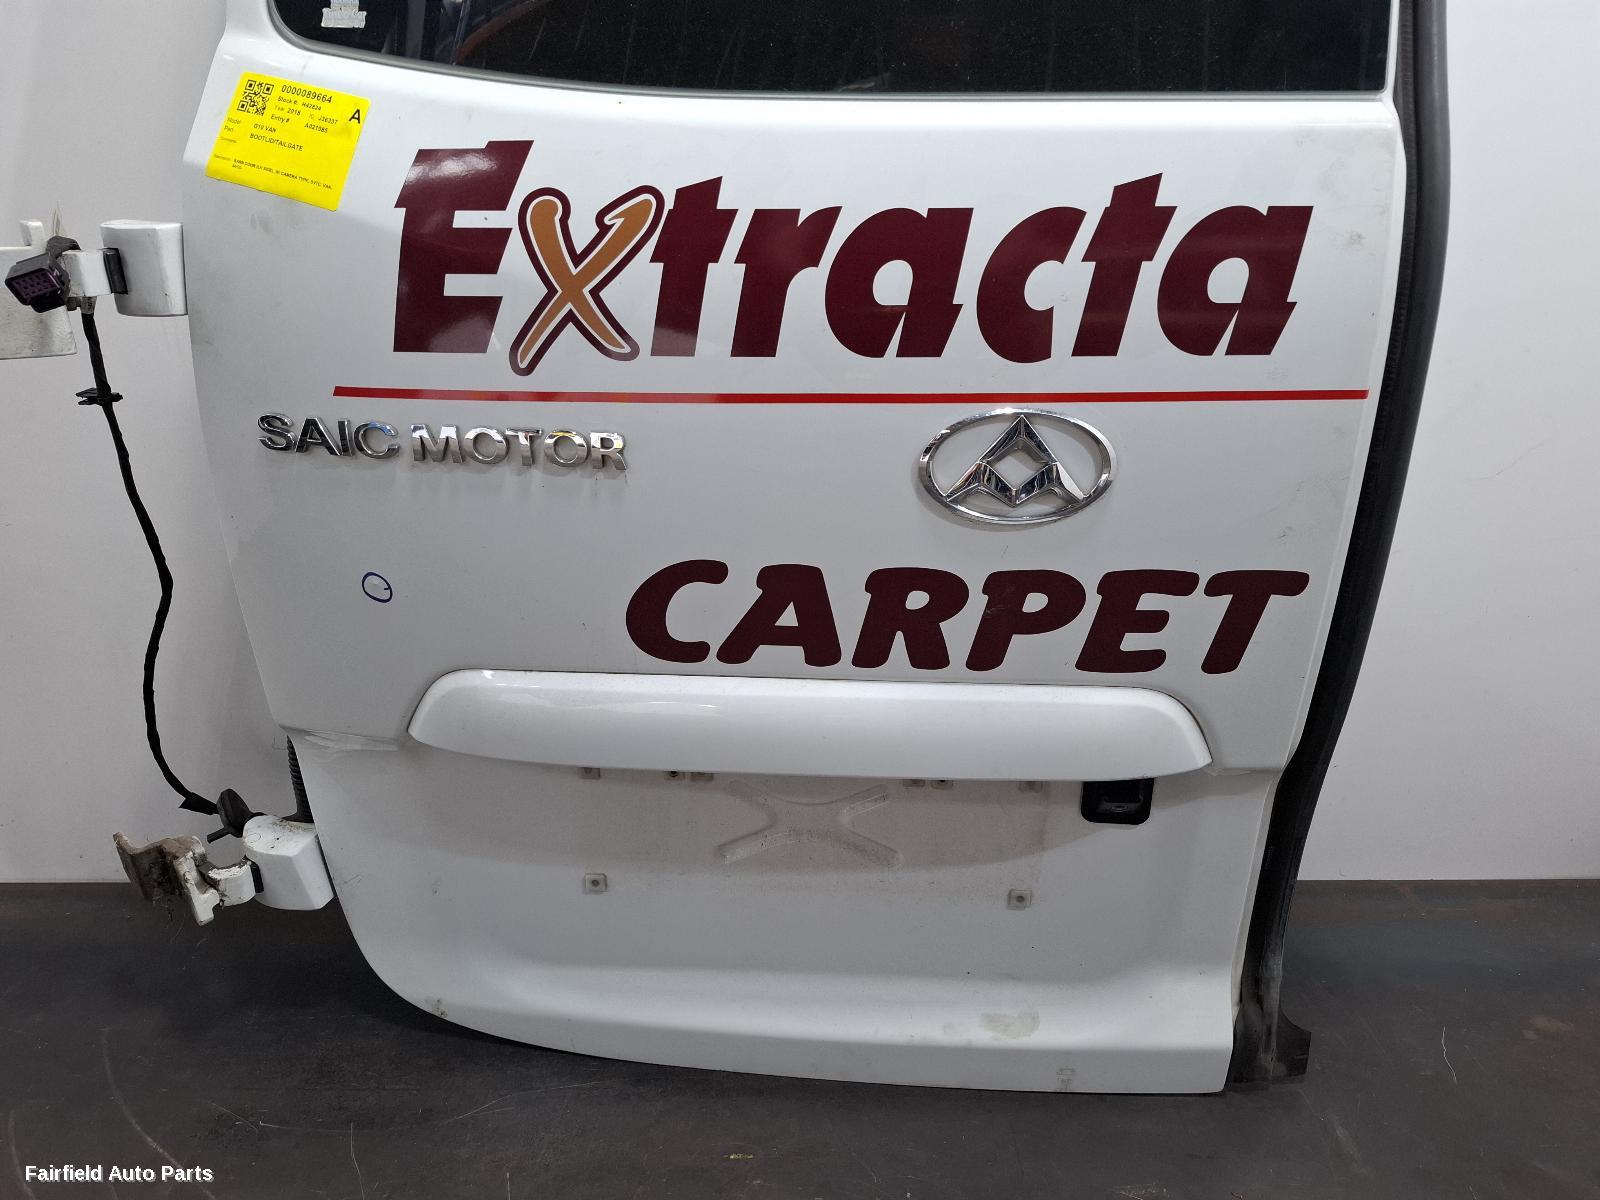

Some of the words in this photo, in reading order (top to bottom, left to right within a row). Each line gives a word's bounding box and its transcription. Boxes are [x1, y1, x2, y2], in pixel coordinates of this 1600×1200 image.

[277, 96, 293, 104] Stock
[281, 84, 333, 103] 0000089664
[270, 113, 286, 123] Entry
[287, 108, 301, 116] 2018
[348, 108, 361, 124] A
[265, 125, 277, 133] VAN
[249, 133, 304, 151] BOOTLID/TAILGATE
[280, 171, 298, 180] CAMERA
[392, 139, 1314, 377] Extracta
[257, 412, 401, 460] SAIC
[410, 423, 628, 472] MOTOR
[625, 559, 1310, 675] CARPET
